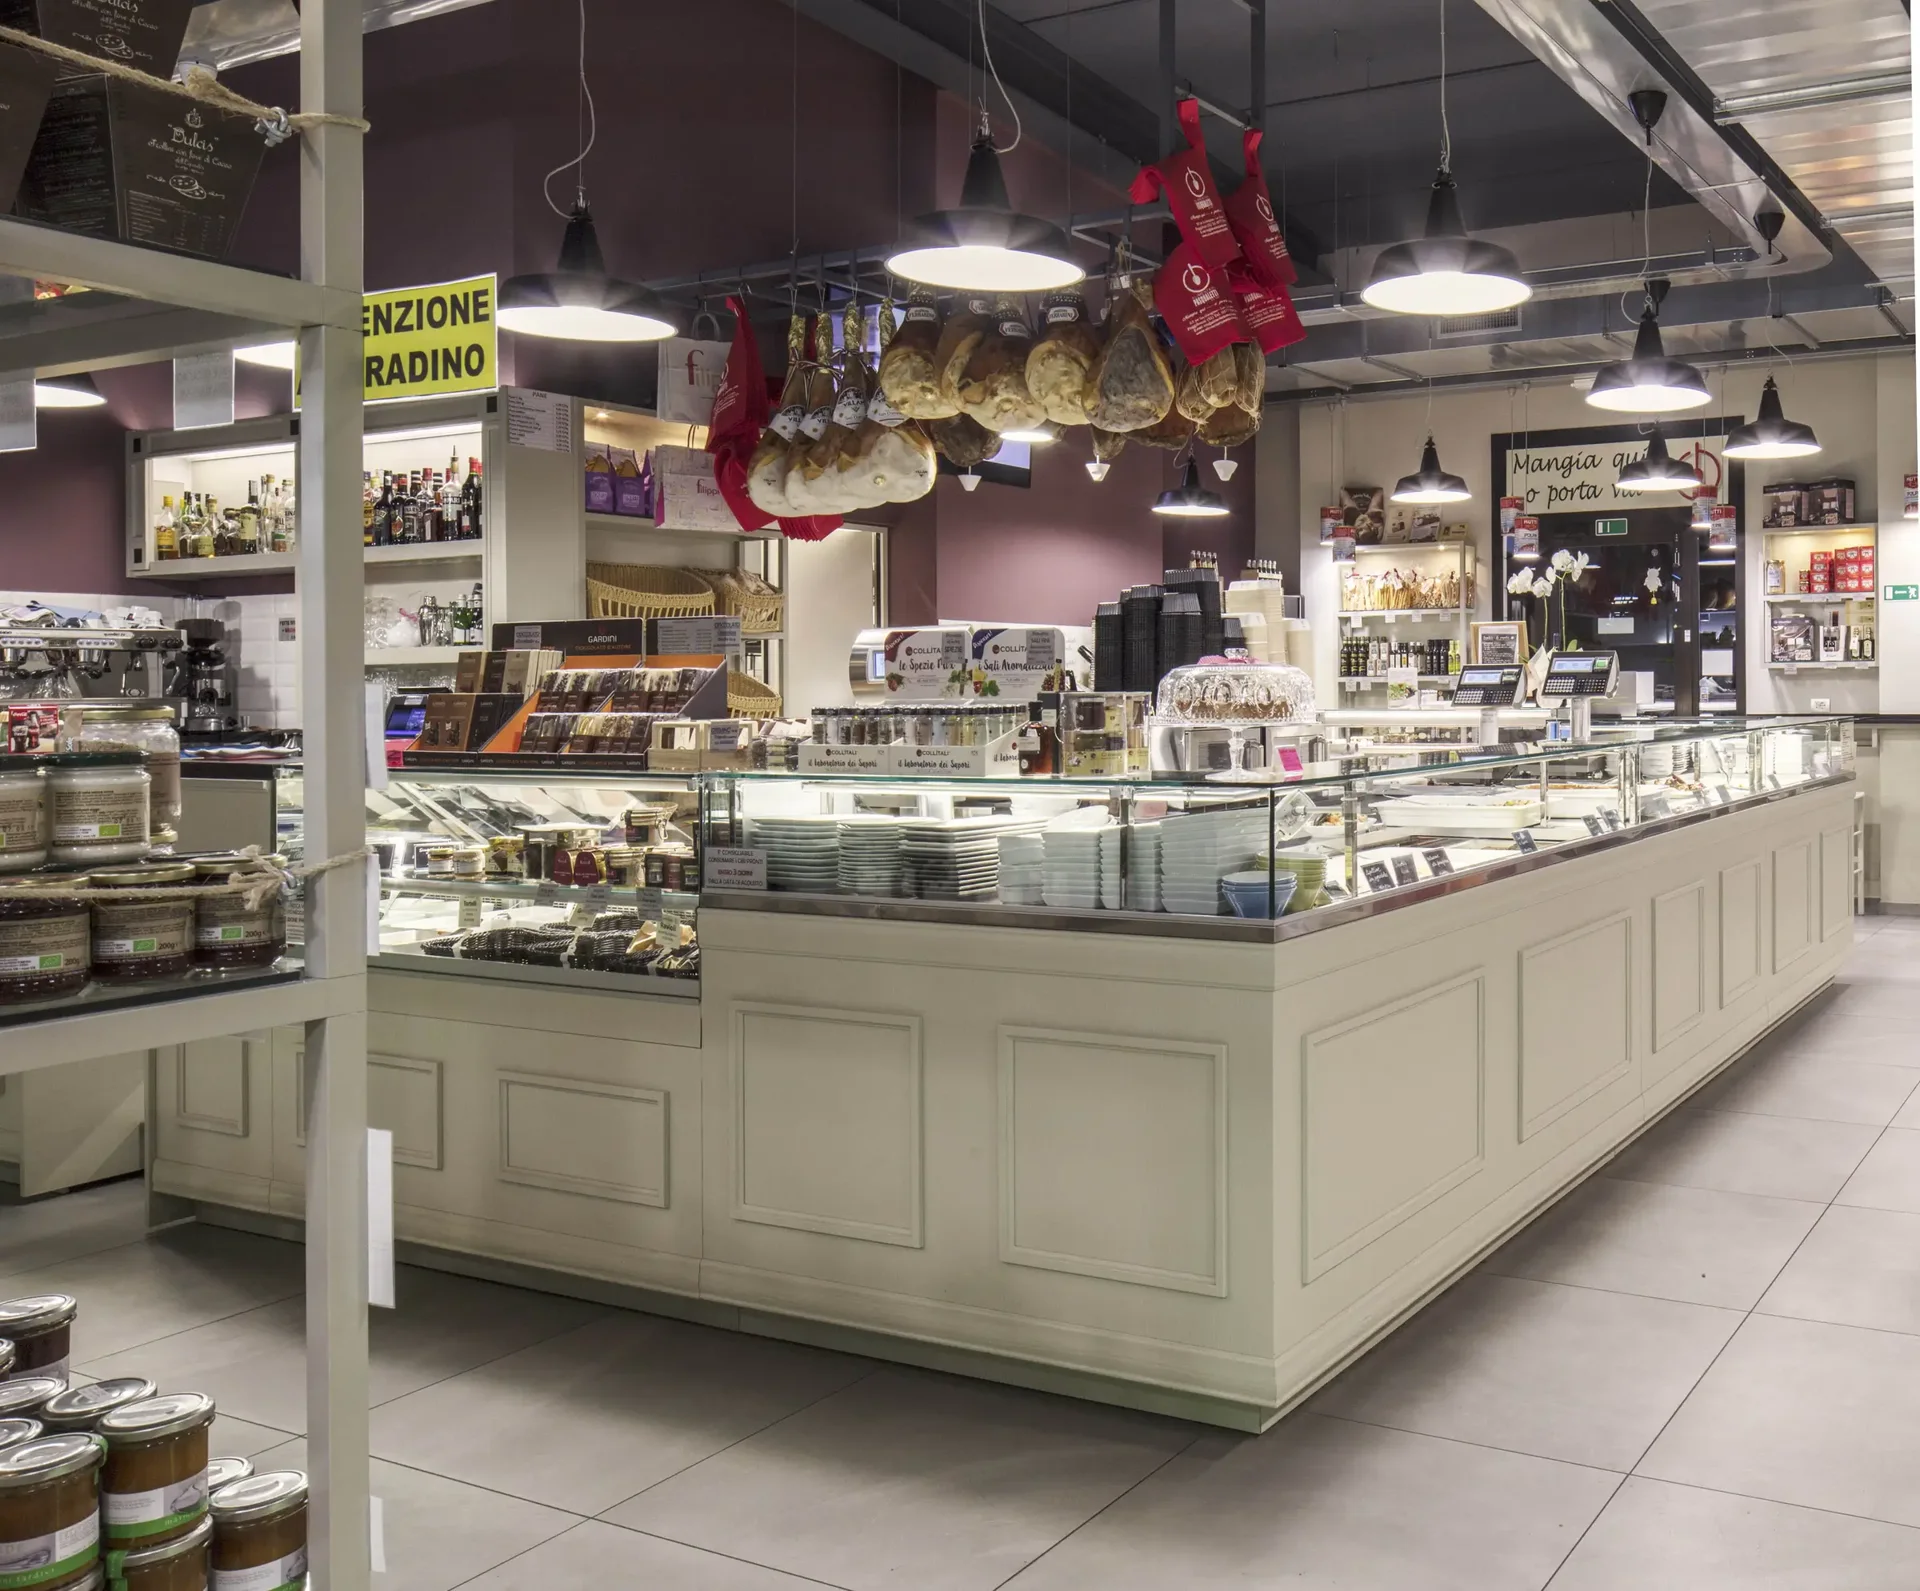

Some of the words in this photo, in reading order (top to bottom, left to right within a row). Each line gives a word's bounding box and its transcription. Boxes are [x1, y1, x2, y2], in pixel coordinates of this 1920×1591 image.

[366, 344, 484, 387] RADINO
[1513, 451, 1603, 479] Mangia
[1526, 490, 1540, 503] o
[1547, 480, 1604, 509] porta
[588, 635, 617, 643] GARDINI
[909, 659, 935, 673] Spezie
[858, 758, 877, 769] Sapori
[950, 759, 970, 769] Sapori
[245, 930, 262, 939] 200g
[158, 942, 176, 951] 200g
